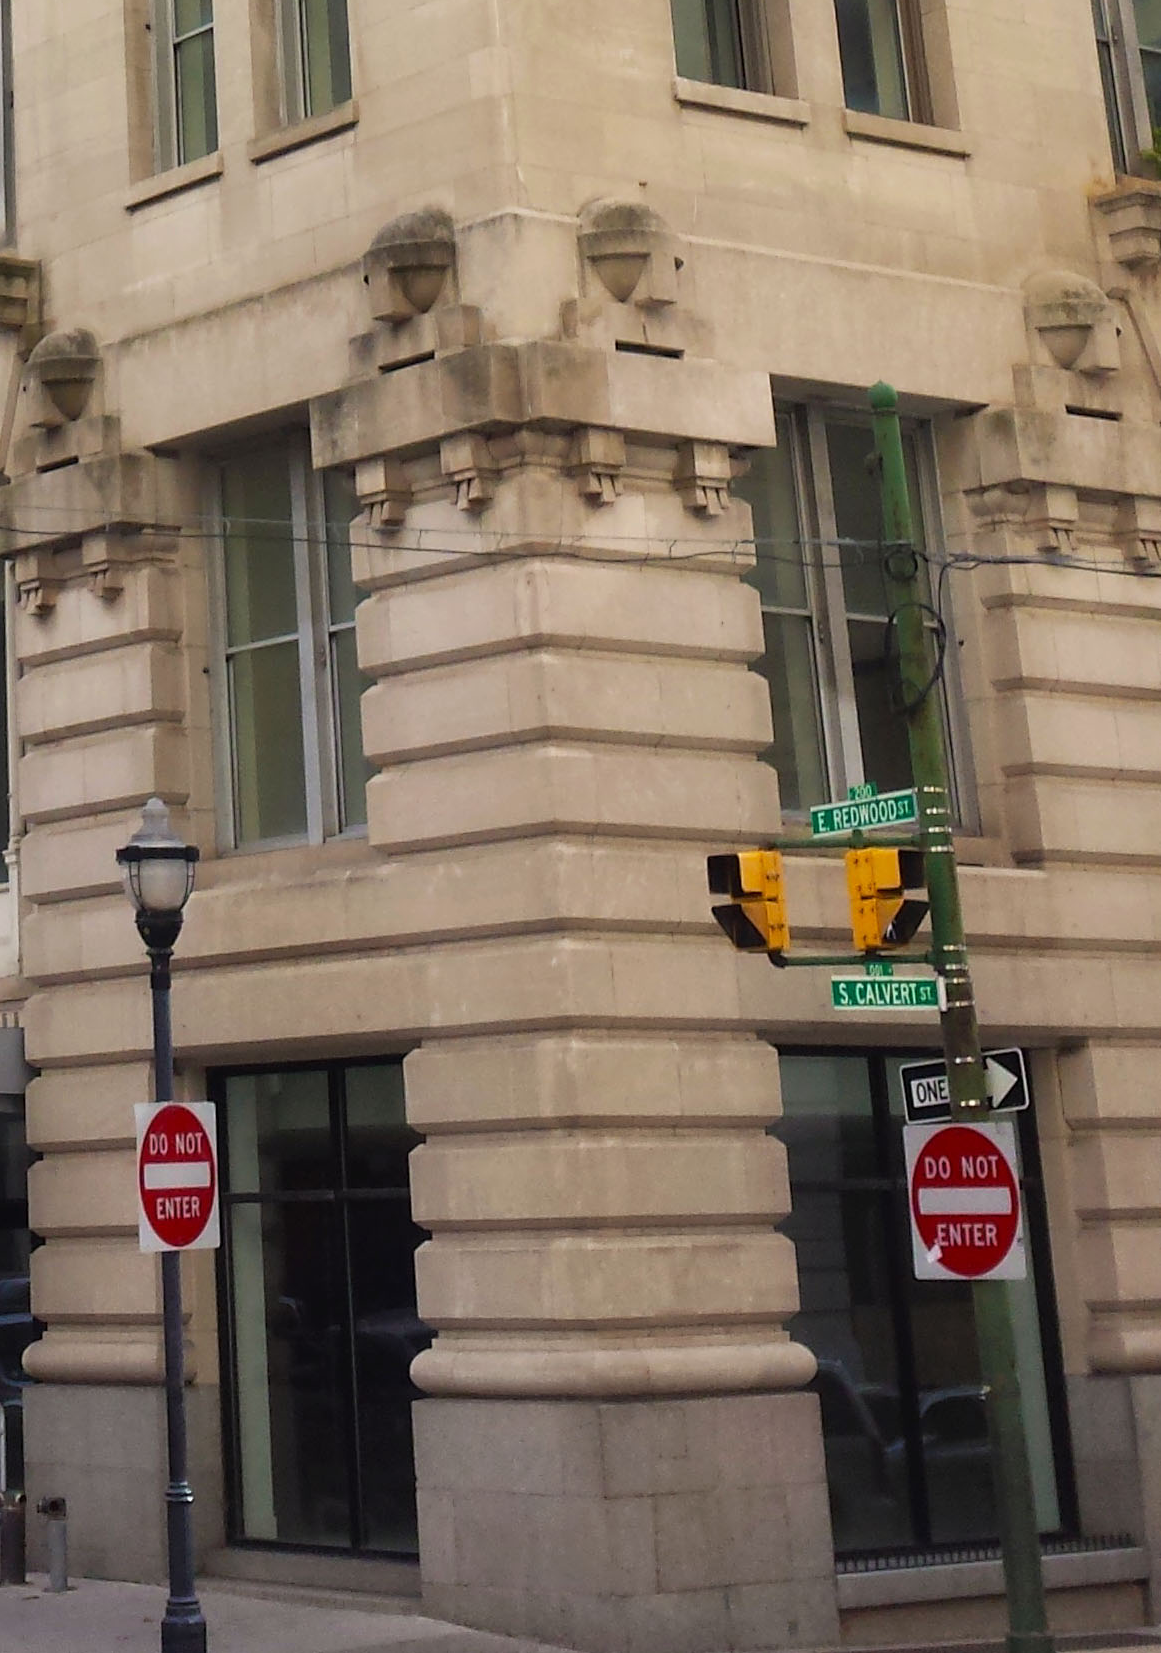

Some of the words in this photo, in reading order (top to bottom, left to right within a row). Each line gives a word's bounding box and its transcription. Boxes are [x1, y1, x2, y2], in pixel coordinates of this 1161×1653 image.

[833, 800, 897, 829] REDWOOD
[856, 982, 917, 1005] CALVERT
[916, 1079, 949, 1104] ONE
[149, 1133, 169, 1155] DO
[175, 1132, 203, 1155] NOT
[924, 1156, 951, 1179] DO
[961, 1155, 999, 1179] NOT
[156, 1196, 201, 1220] ENTER
[937, 1223, 998, 1247] ENTER
